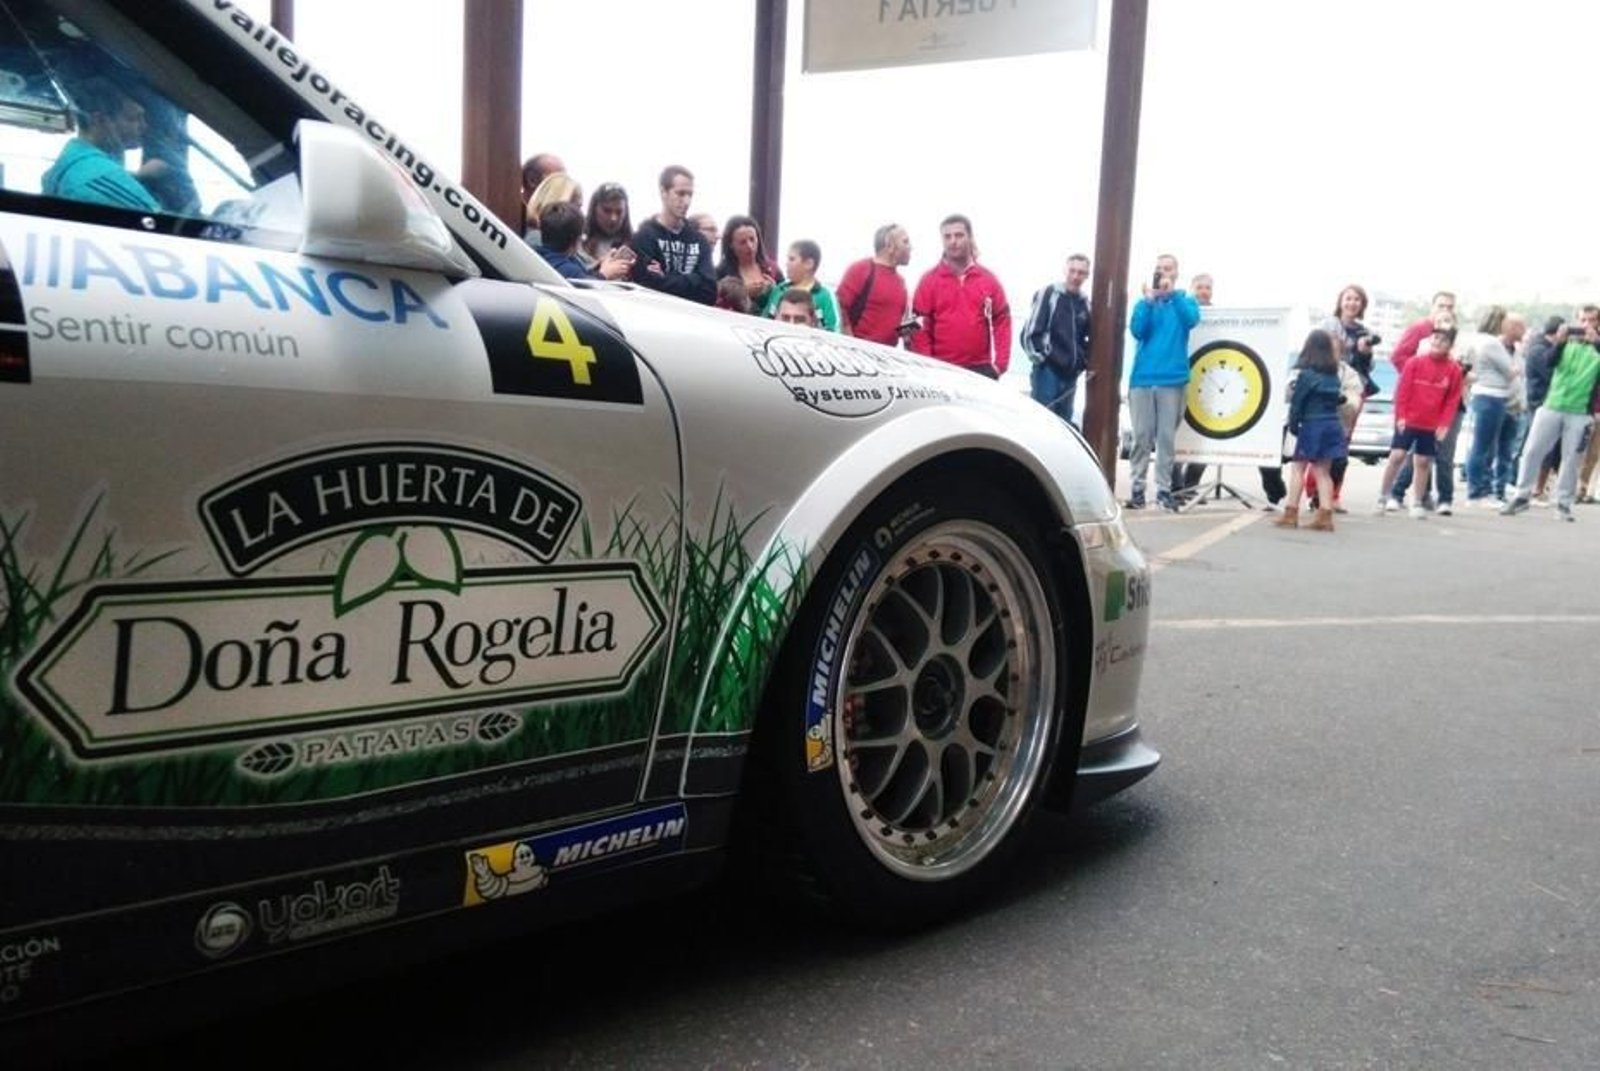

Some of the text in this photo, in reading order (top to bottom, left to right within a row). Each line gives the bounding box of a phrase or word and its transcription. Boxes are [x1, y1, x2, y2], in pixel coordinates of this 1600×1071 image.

[29, 306, 300, 358] Sentir común
[526, 297, 597, 386] 4
[793, 386, 882, 404] Systems
[231, 463, 563, 548] LA HUERTA DE
[104, 587, 618, 716] Doña Rogelia
[811, 550, 873, 709] MICHELIN
[305, 721, 471, 763] PATATAS
[552, 817, 685, 866] MICHELIN
[0, 935, 62, 963] CIÓN
